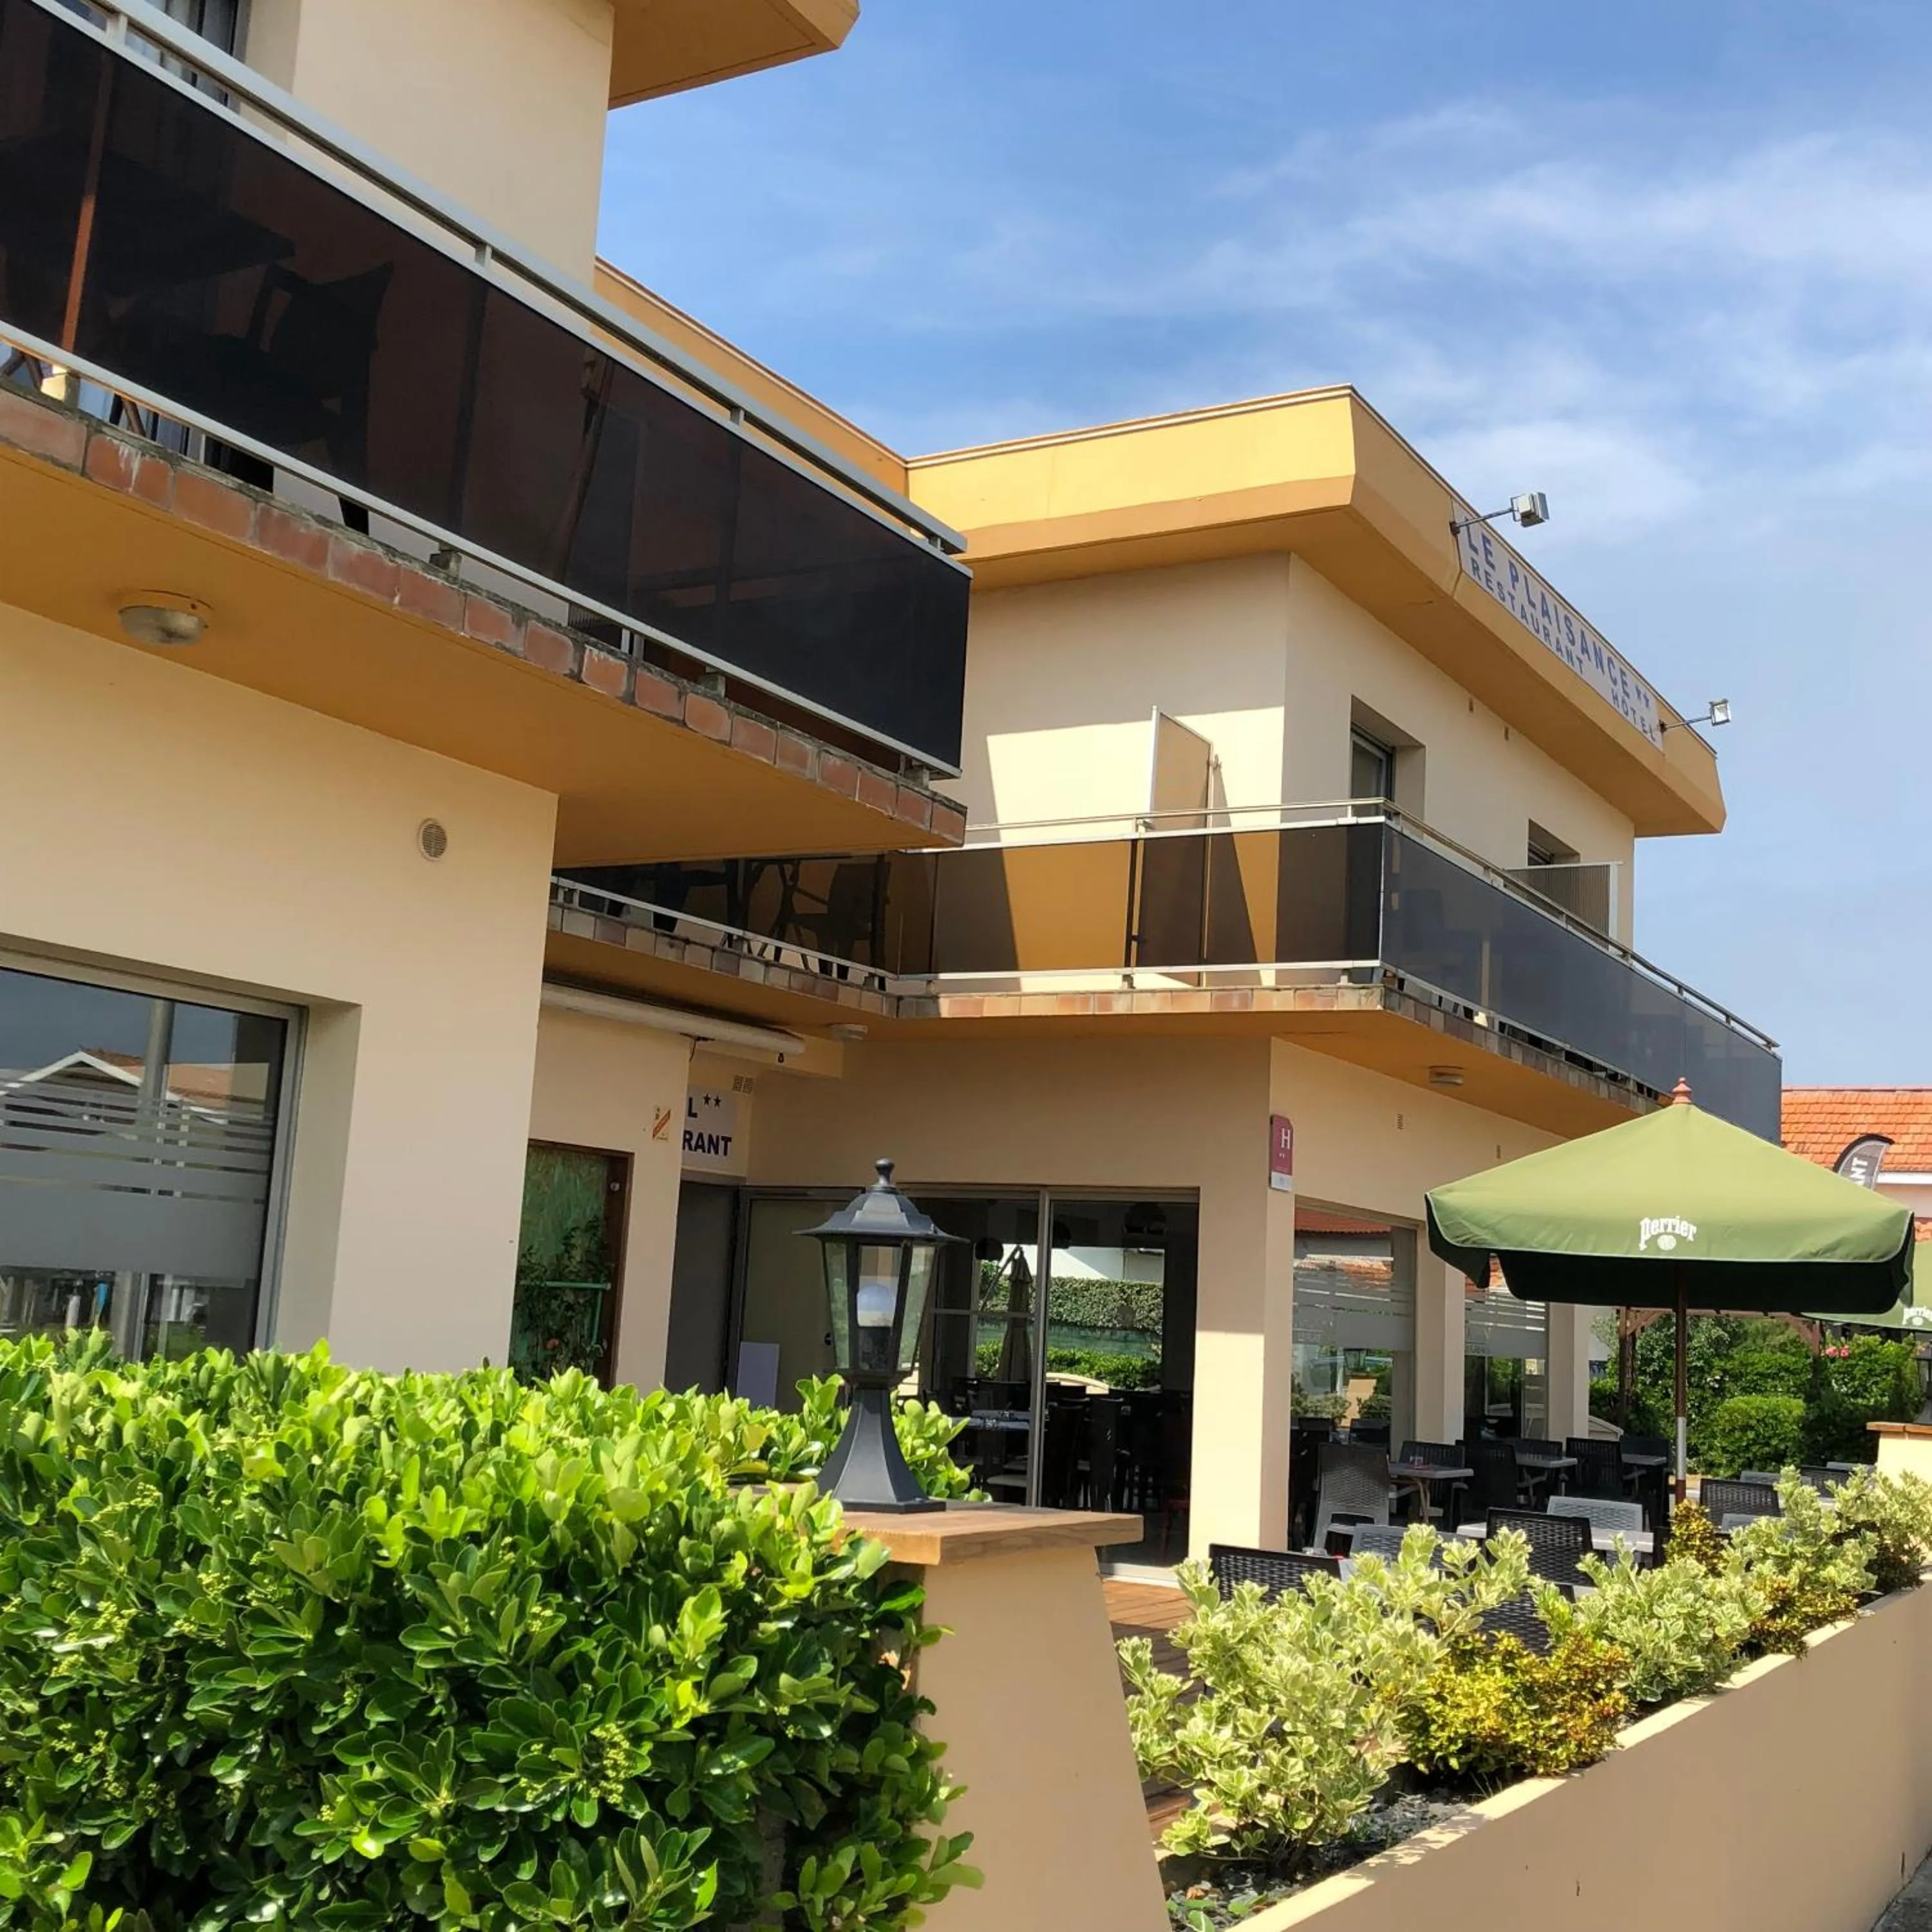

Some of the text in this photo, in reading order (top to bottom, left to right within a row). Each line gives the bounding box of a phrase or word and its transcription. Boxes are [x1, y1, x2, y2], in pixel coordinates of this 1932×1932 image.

[1464, 516, 1631, 699] LE PLAISANCE
[1470, 556, 1584, 674] RESTAURANT
[1611, 688, 1656, 743] HOTEL
[1281, 1128, 1291, 1150] H
